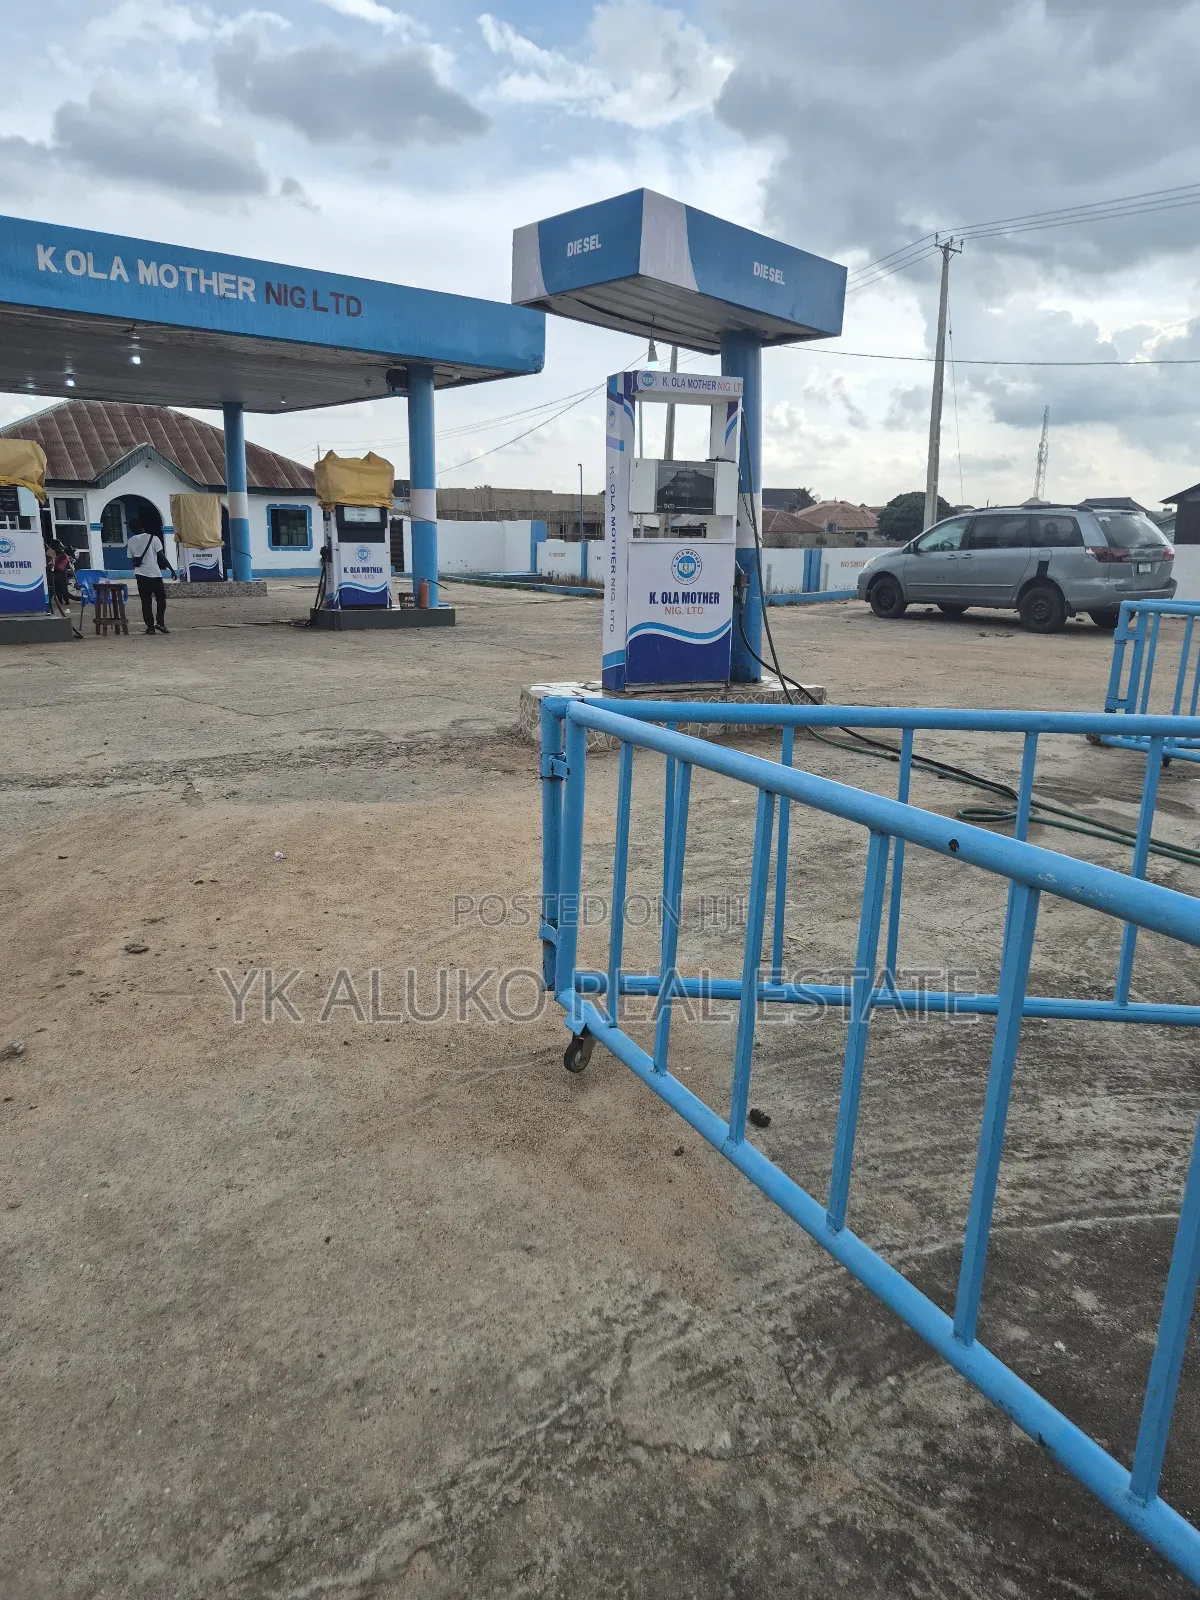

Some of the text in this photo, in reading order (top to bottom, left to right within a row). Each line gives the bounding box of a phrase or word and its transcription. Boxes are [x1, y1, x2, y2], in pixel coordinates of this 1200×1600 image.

[566, 233, 602, 258] DIESEL
[136, 258, 256, 303] MOTHER
[753, 261, 786, 286] DIESEL
[662, 376, 670, 387] K.
[671, 377, 686, 388] OLA
[687, 379, 717, 390] MOTHER
[717, 381, 732, 392] NIG.
[4, 560, 32, 568] MOTHER
[343, 566, 350, 574] K.
[362, 566, 384, 574] MOTHER
[649, 592, 720, 604] K. OLA MOTHER
[664, 606, 706, 615] NIG. LTD.
